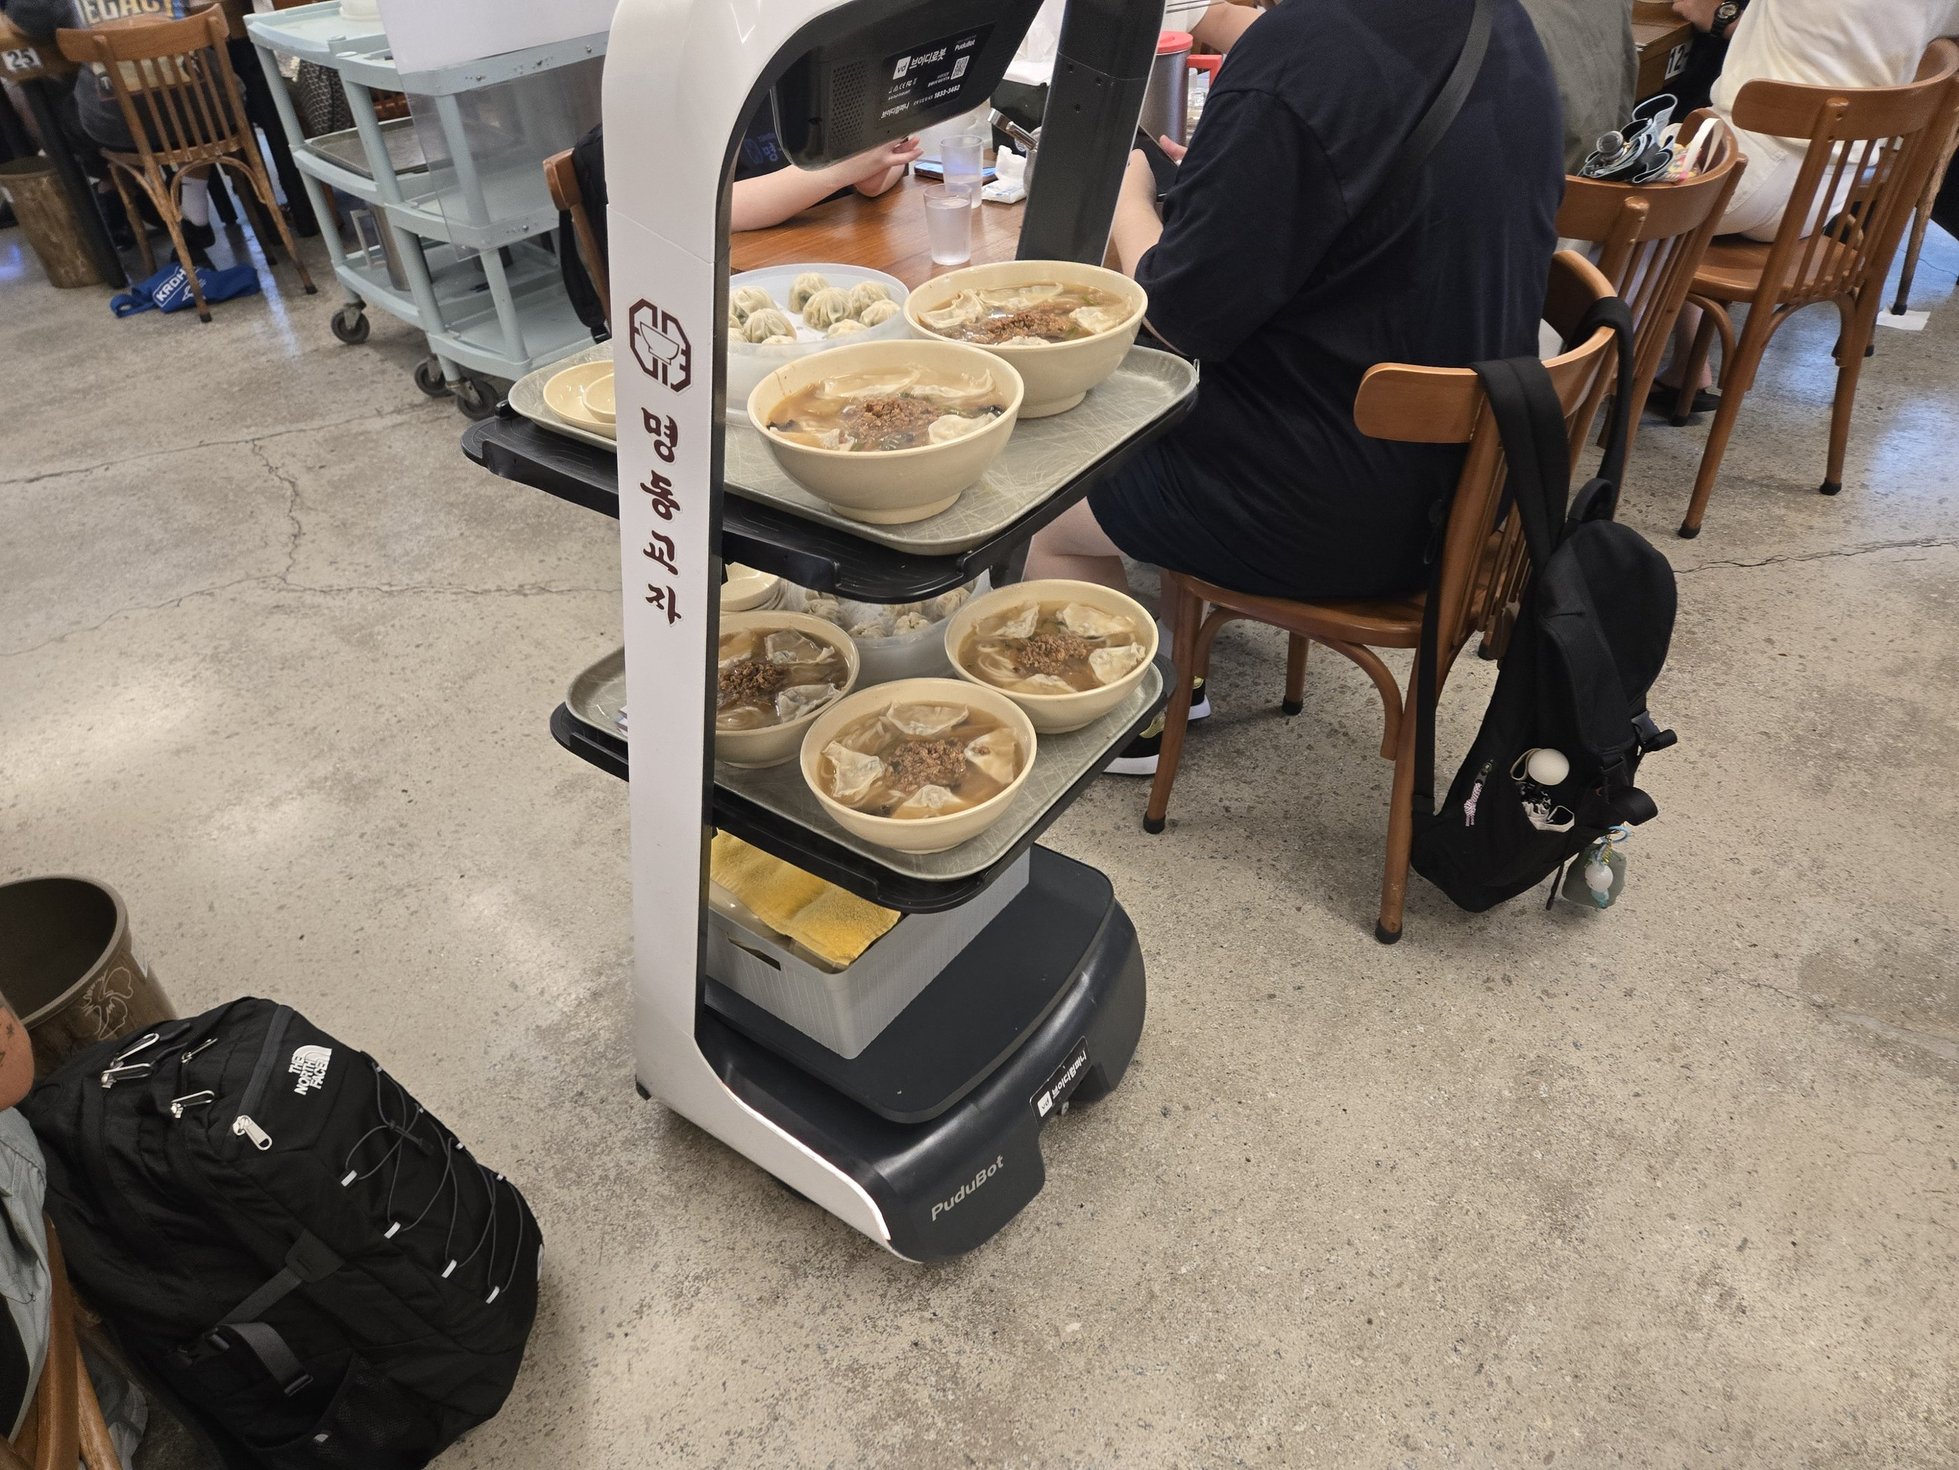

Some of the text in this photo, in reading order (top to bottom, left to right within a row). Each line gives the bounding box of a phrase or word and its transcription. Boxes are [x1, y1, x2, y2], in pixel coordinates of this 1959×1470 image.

[7, 49, 35, 68] 25
[909, 47, 947, 70] 브이디로봇
[640, 406, 682, 625] 명동교자
[288, 1055, 305, 1074] THE
[294, 1060, 316, 1096] NORTH
[309, 1061, 328, 1090] FACE
[931, 1154, 1004, 1222] PuduBot
